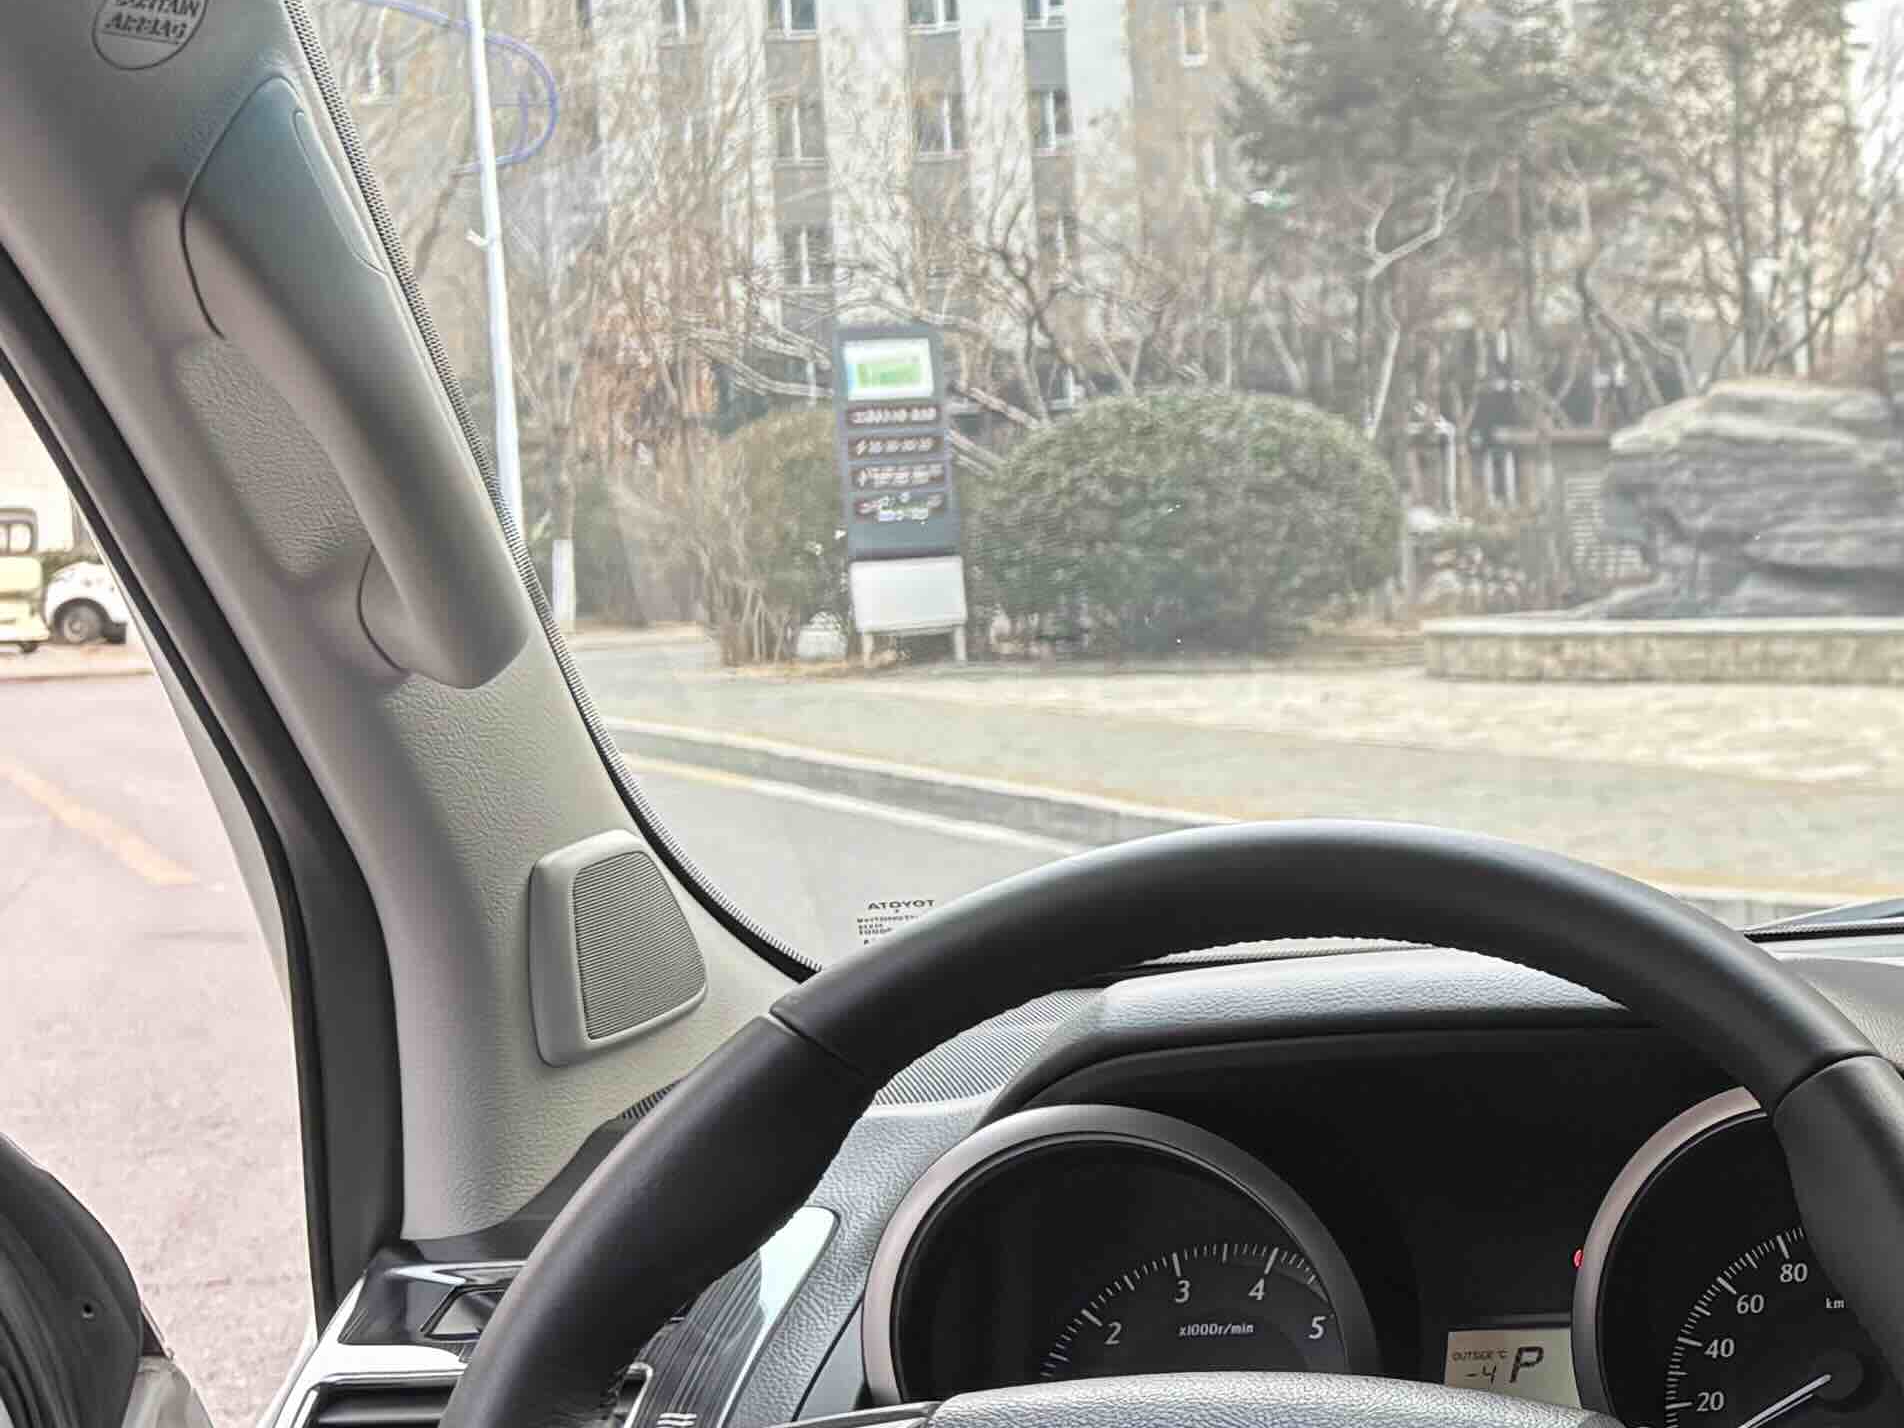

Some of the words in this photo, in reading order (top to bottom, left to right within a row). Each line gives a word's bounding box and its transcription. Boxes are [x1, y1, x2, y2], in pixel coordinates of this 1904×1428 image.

[1779, 1262, 1809, 1283] 80
[1174, 1279, 1191, 1304] 3
[1248, 1277, 1266, 1301] 4
[1736, 1294, 1765, 1314] 60
[1104, 1322, 1123, 1345] 2
[1308, 1316, 1327, 1339] 5
[1704, 1338, 1736, 1358] 40
[1509, 1345, 1545, 1384] P
[1696, 1391, 1725, 1412] 20
